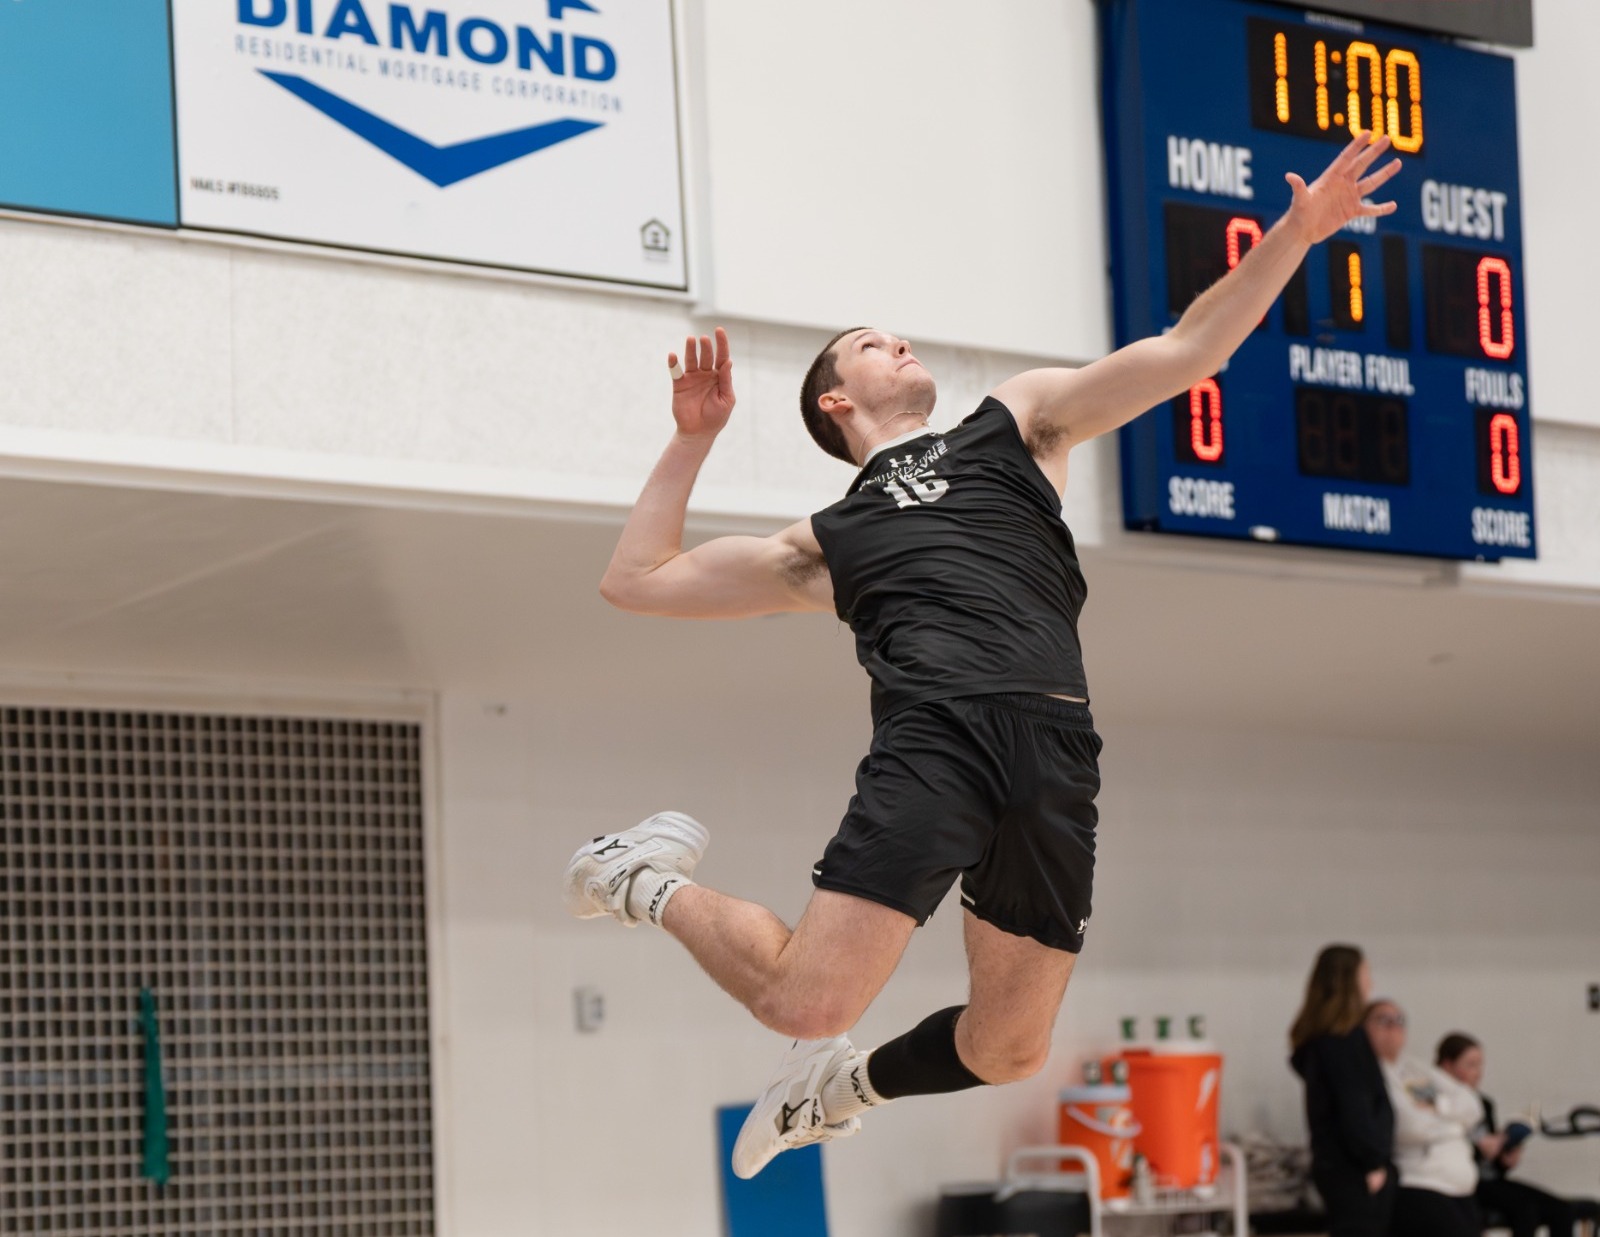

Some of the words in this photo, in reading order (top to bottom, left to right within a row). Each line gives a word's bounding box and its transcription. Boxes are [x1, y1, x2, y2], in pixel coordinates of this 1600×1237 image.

[235, 35, 368, 74] RESIDENTIAL
[378, 57, 482, 92] MORTGAGE
[491, 76, 623, 112] CORPORATION
[237, 0, 617, 82] DIAMOND
[1274, 32, 1424, 153] 11:00
[1167, 135, 1254, 199] HOME
[1421, 179, 1508, 241] GUEST
[1348, 252, 1363, 322] 1
[1476, 257, 1515, 359] 0
[1289, 344, 1363, 387] PLAYER
[1366, 355, 1415, 394] FOUL
[1465, 368, 1524, 408] FOULS
[1189, 377, 1223, 461] 0
[1489, 413, 1521, 494] 0
[1168, 476, 1235, 518] SCORE
[1323, 493, 1391, 533] MATCH
[1471, 507, 1530, 548] SCORE
